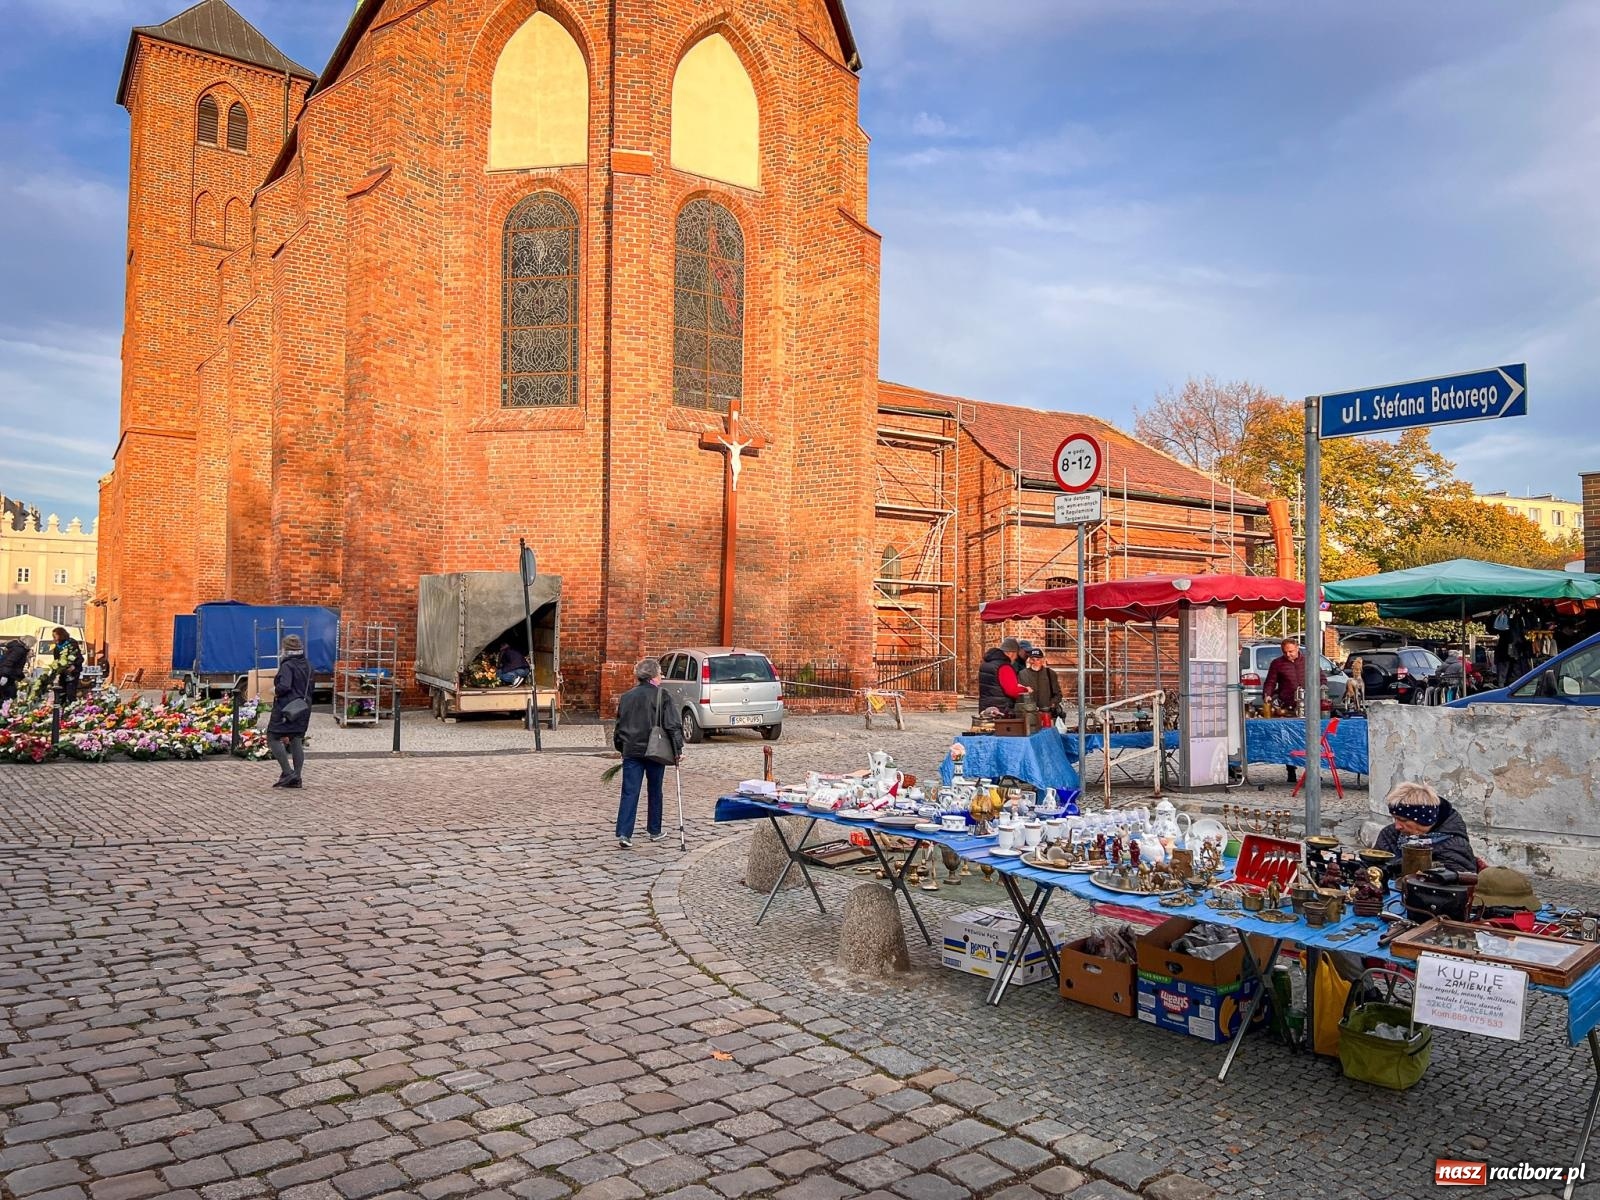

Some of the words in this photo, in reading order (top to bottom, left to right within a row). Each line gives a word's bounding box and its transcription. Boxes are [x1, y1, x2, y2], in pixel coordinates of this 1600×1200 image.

[1342, 399, 1367, 424] ul.
[1372, 392, 1425, 420] Stefana
[1431, 384, 1498, 414] Batorego
[1061, 455, 1091, 472] 8-12
[1437, 965, 1504, 990] KUPIĘ
[1445, 979, 1494, 995] ZAMIENIĘ
